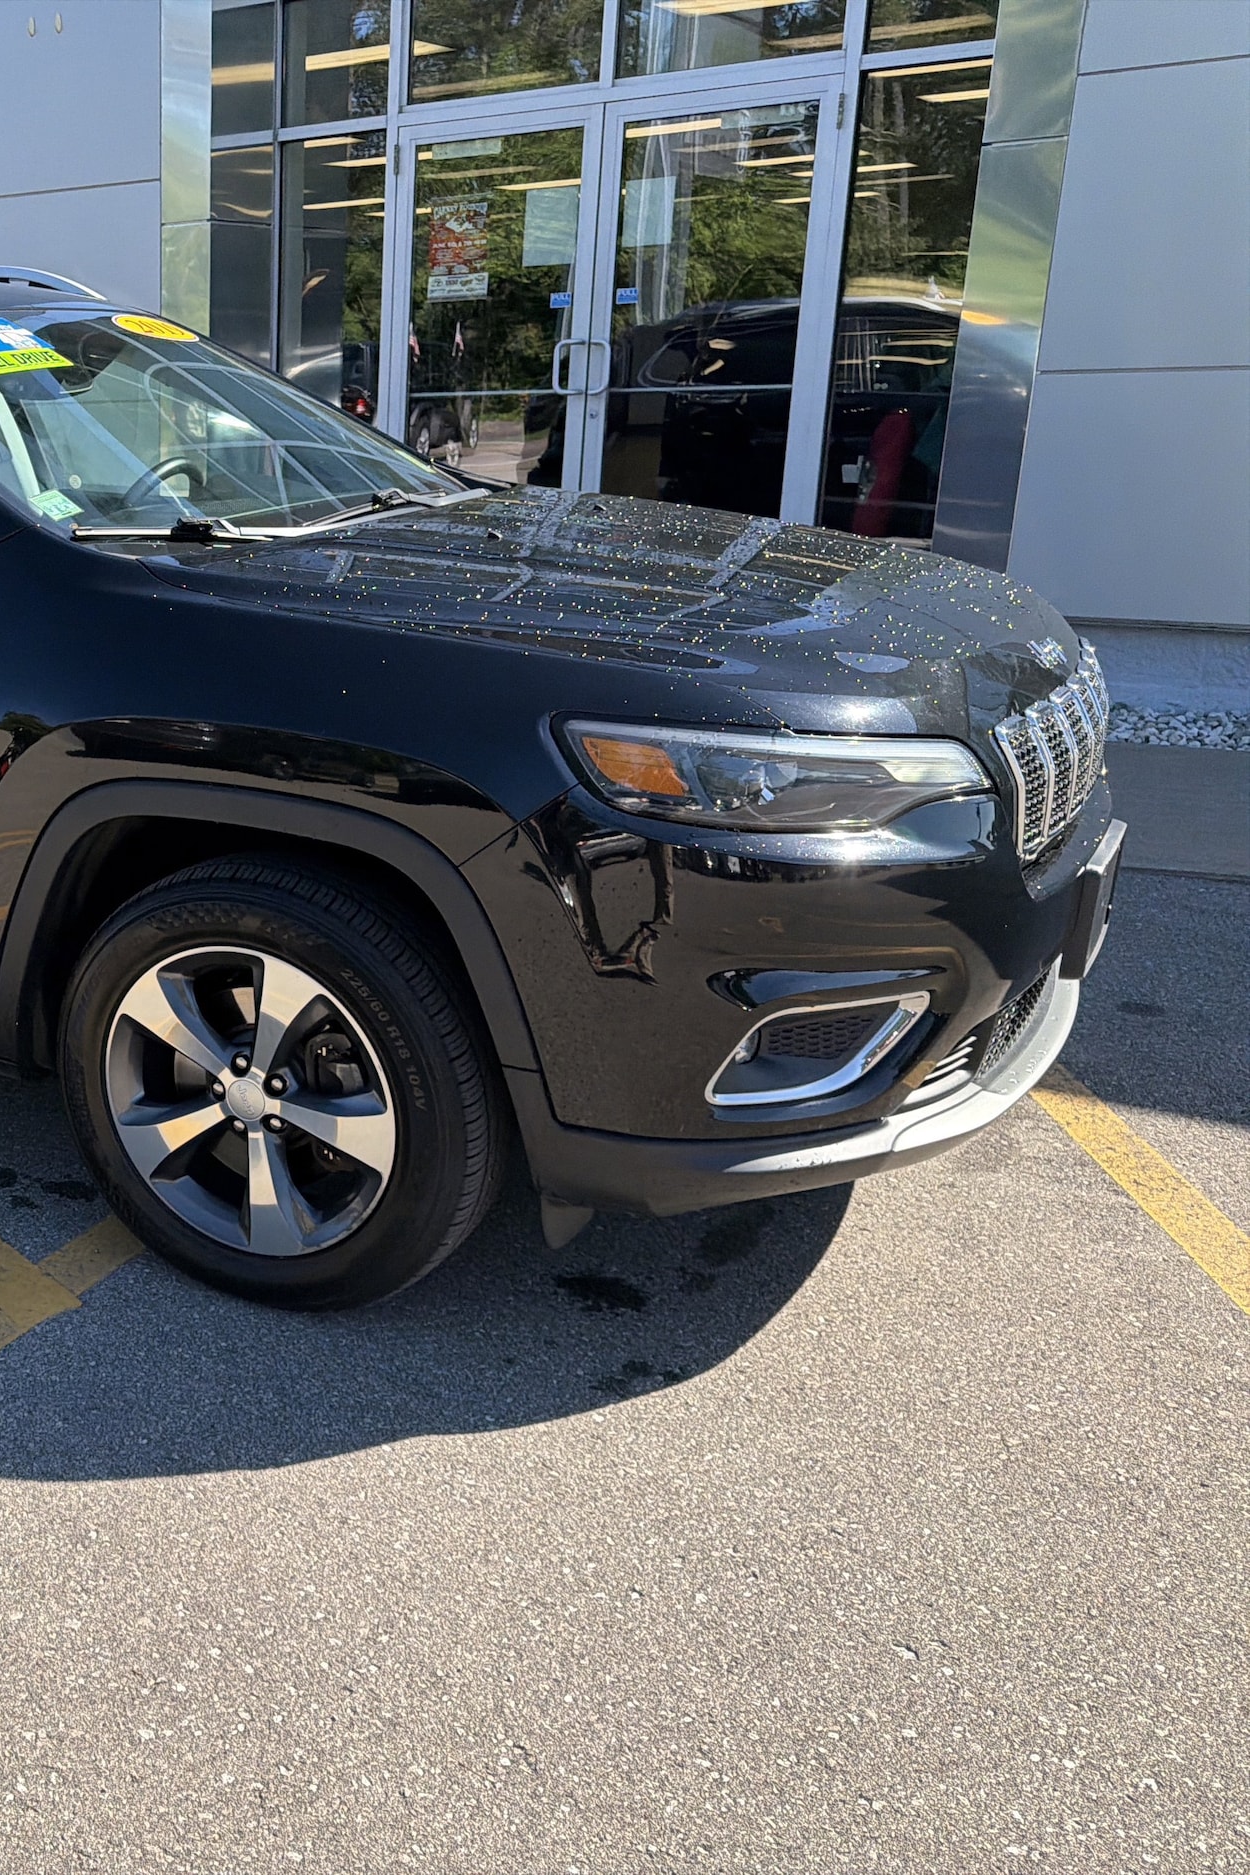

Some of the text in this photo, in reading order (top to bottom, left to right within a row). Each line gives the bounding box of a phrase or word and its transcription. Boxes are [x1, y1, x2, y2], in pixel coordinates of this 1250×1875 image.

[12, 350, 61, 366] DRIVE
[339, 968, 428, 1112] 225/60 R18 104V
[235, 1083, 255, 1116] Jeep
